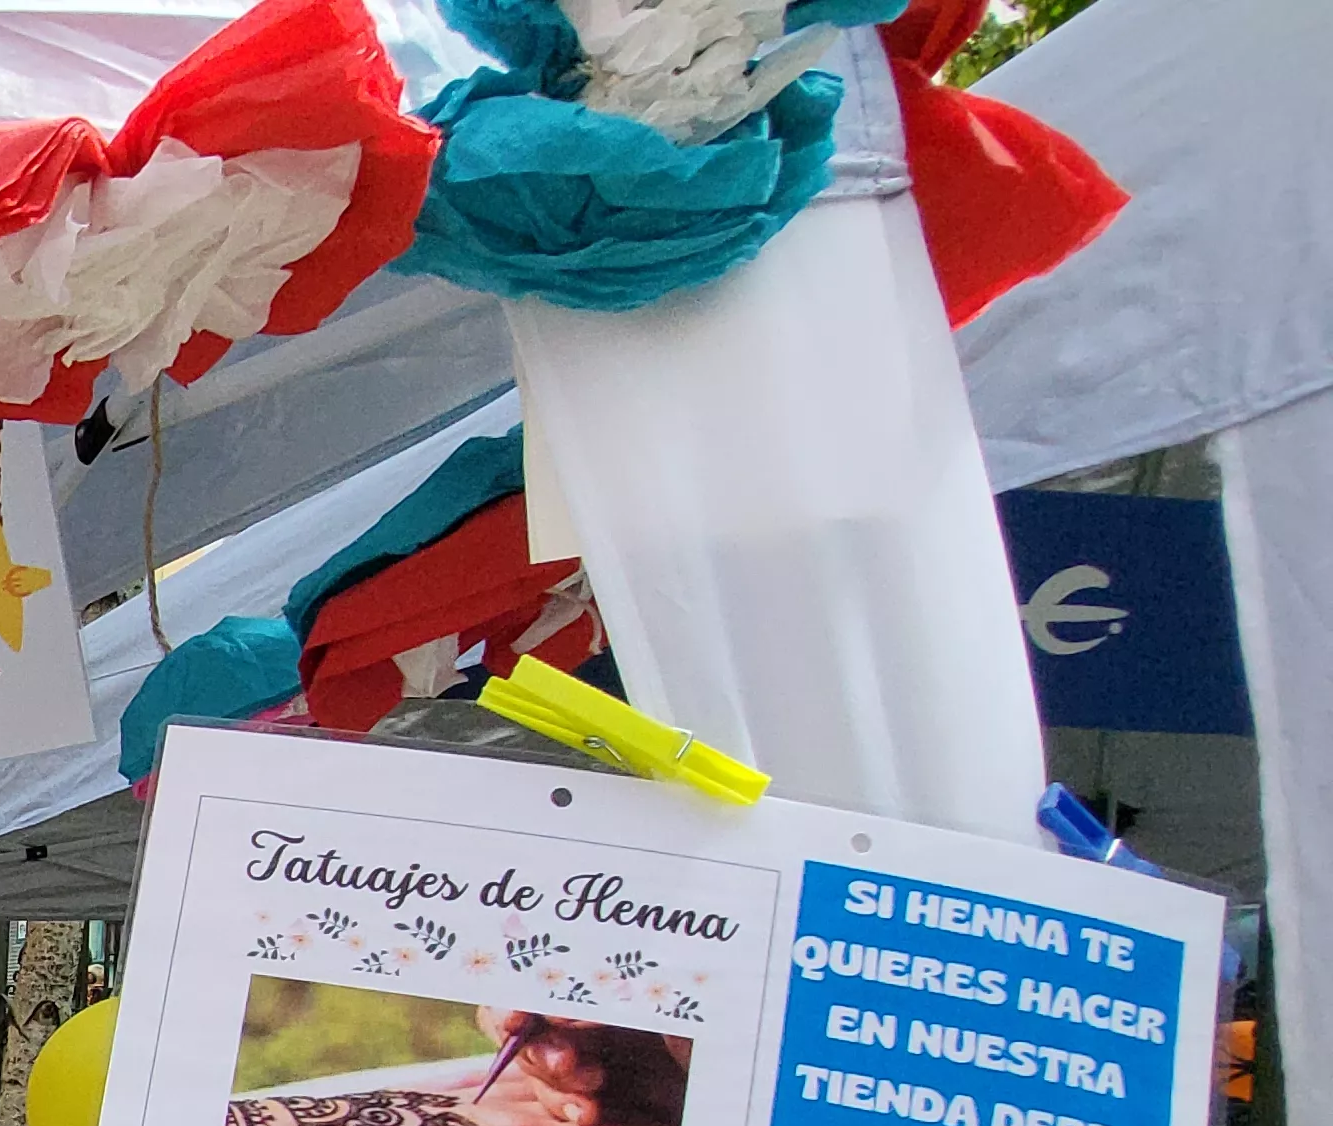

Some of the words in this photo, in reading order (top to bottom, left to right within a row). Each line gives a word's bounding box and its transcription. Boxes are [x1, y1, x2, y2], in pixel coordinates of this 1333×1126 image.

[245, 829, 469, 911] Tatuajes
[479, 867, 544, 912] de
[554, 871, 740, 943] Henna
[843, 879, 896, 920] SI
[904, 889, 1069, 957] HENNA
[1079, 926, 1136, 972] TE
[791, 935, 1009, 1006] QUIERES
[1017, 977, 1168, 1045] HACER
[825, 1003, 898, 1050] EN
[906, 1019, 1127, 1099] NUESTRA
